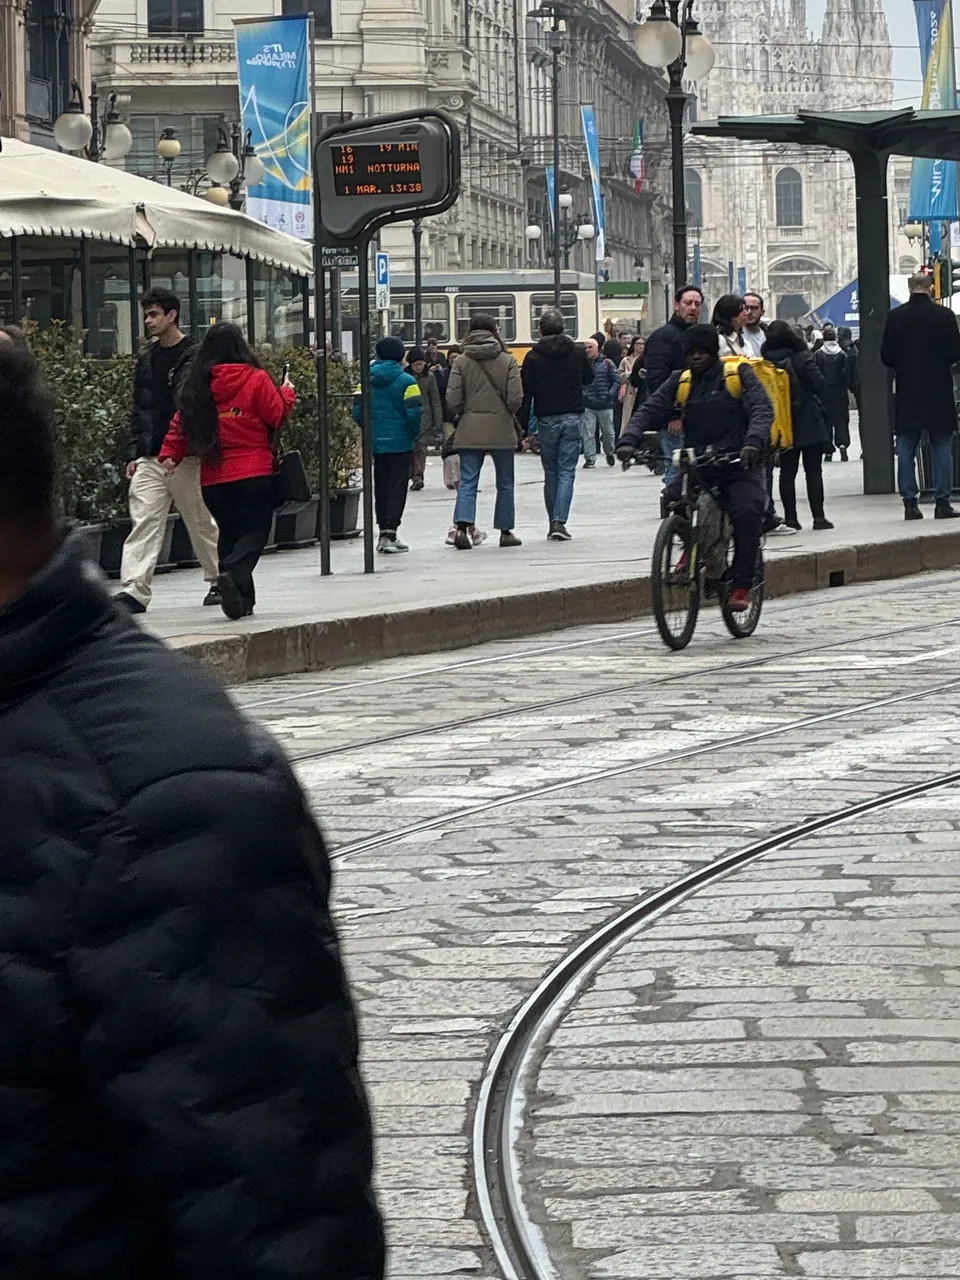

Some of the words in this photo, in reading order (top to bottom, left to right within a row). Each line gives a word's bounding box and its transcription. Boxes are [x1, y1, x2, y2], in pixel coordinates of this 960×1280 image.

[342, 154, 354, 164] 19
[367, 162, 420, 173] NOTTURNA
[356, 184, 382, 194] MAR.
[378, 258, 387, 281] P
